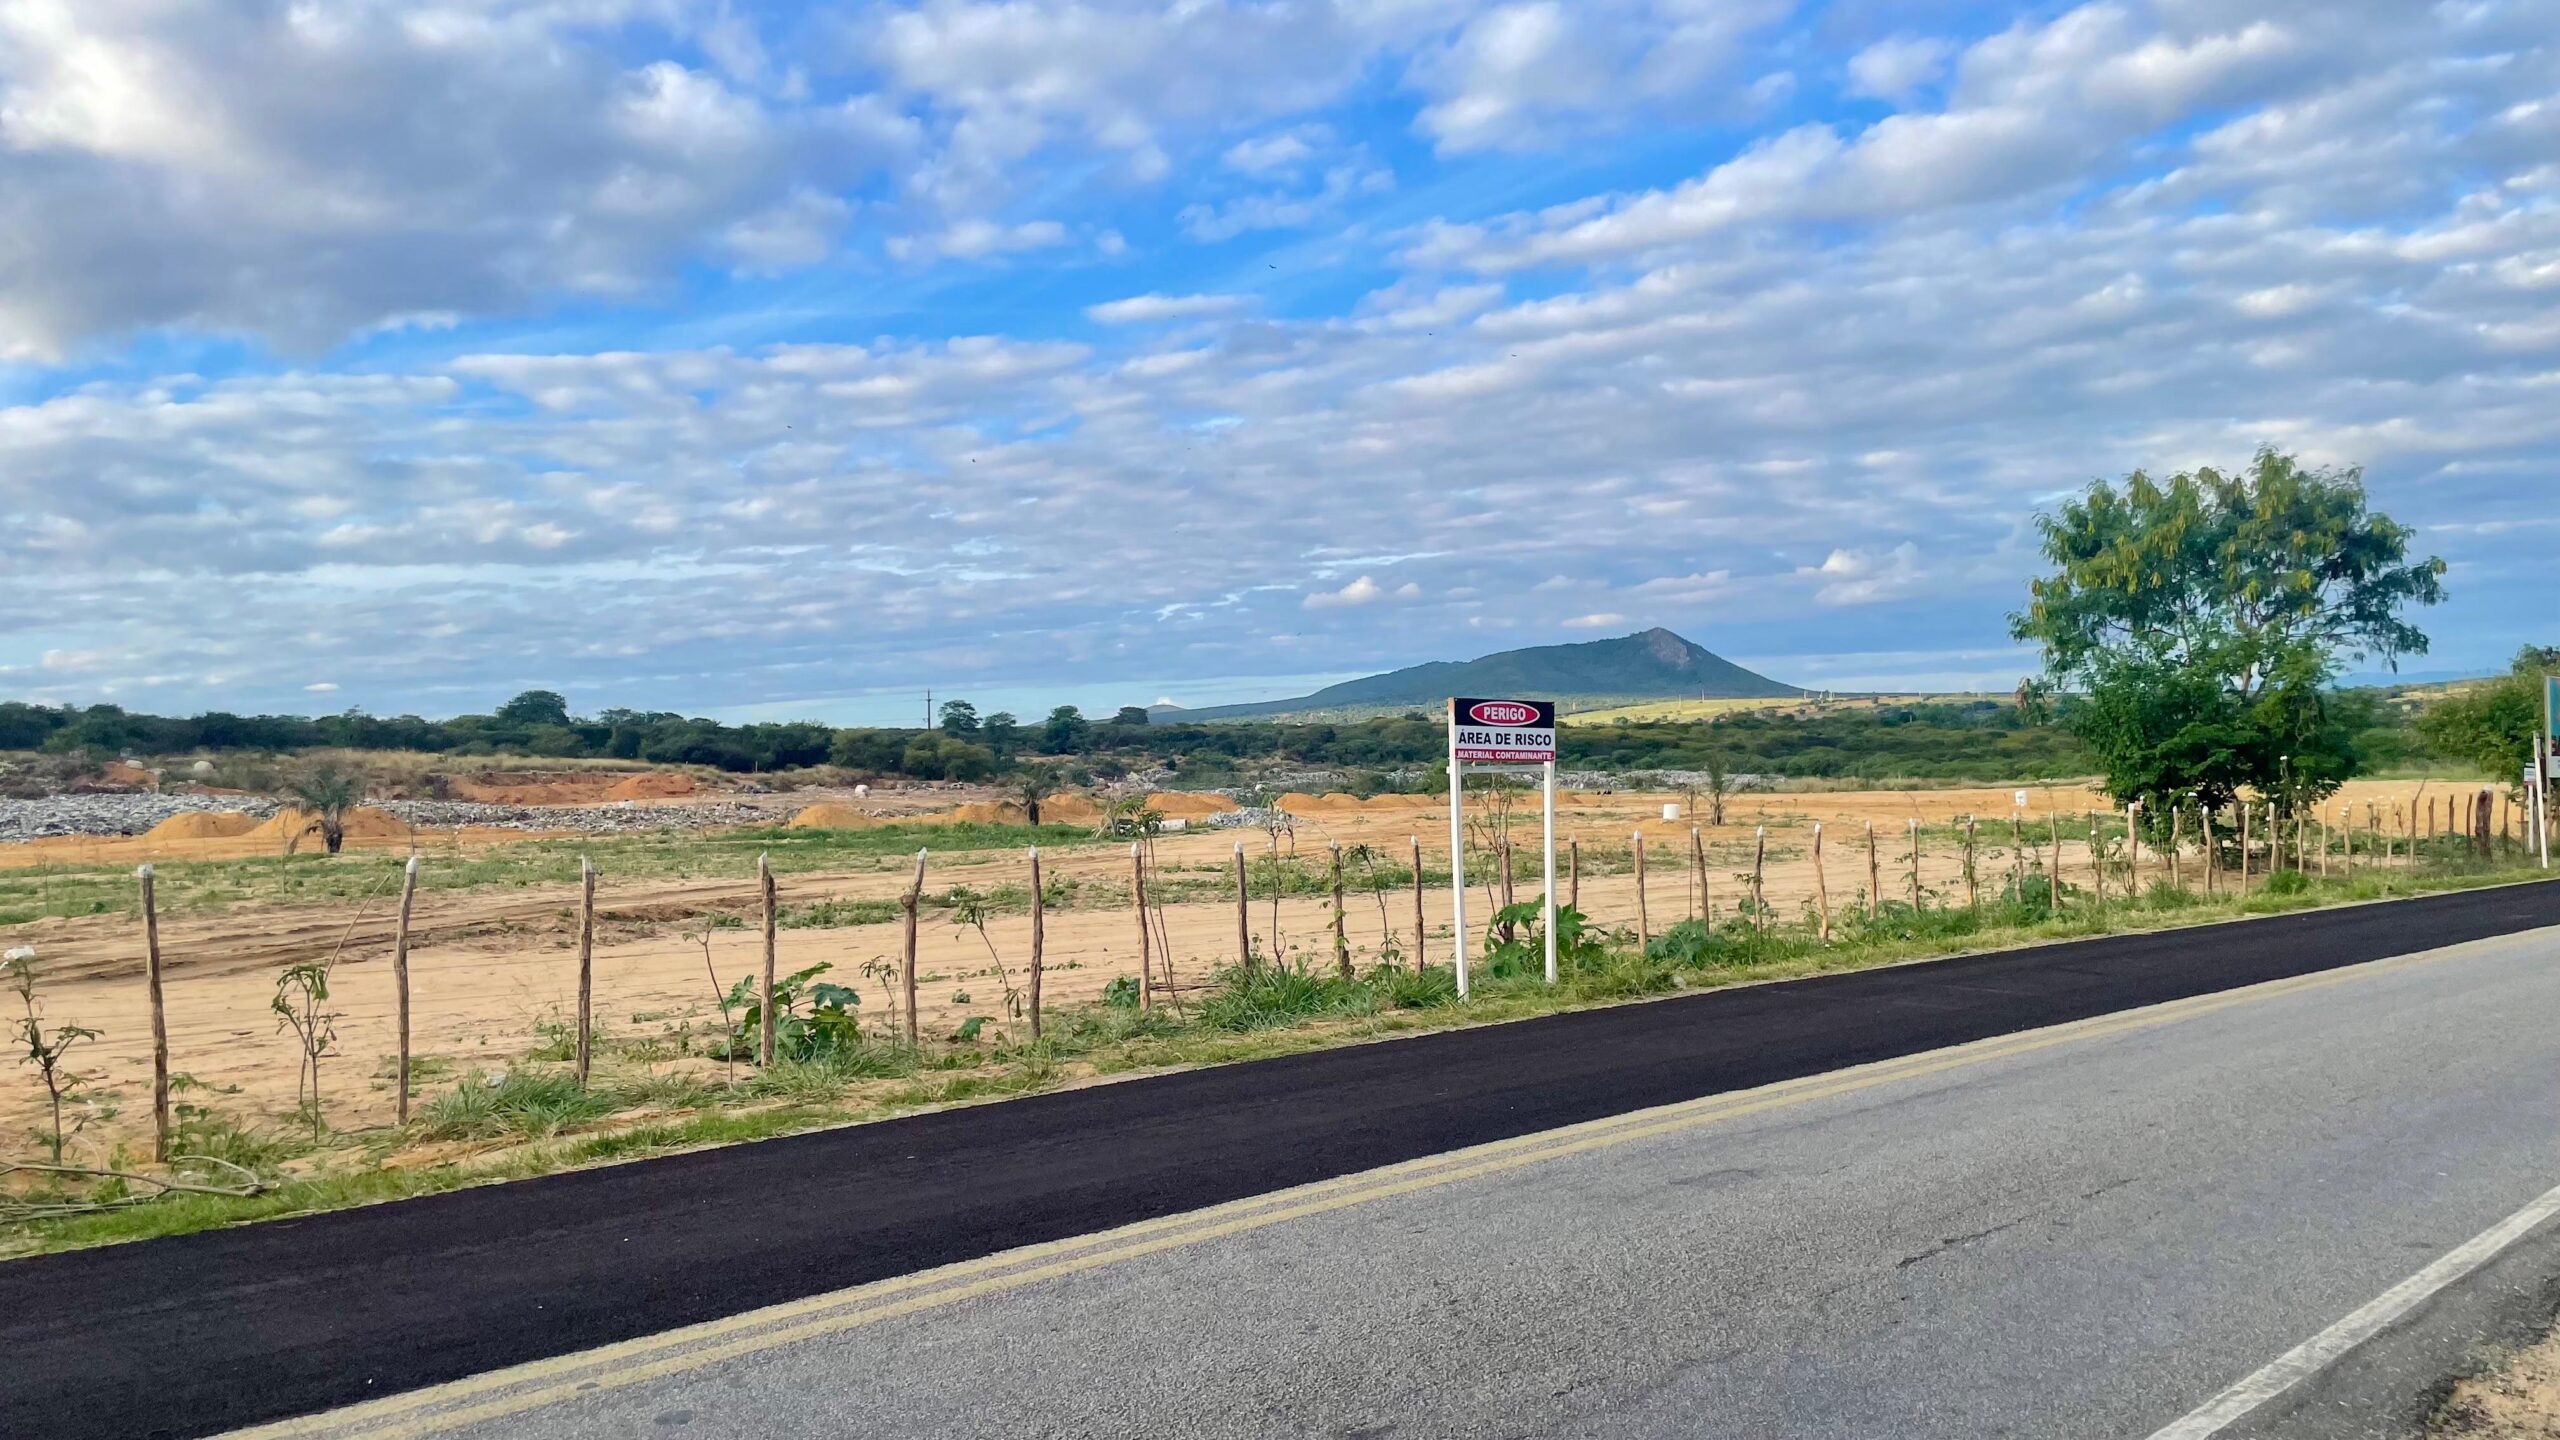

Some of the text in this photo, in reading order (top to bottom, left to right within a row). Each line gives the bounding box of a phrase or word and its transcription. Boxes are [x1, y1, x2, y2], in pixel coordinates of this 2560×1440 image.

[1483, 706, 1526, 721] PERIGO
[1458, 729, 1552, 746] ÁREA DE RISCO
[1457, 750, 1552, 760] MATERIAL CONTAMINANTE
